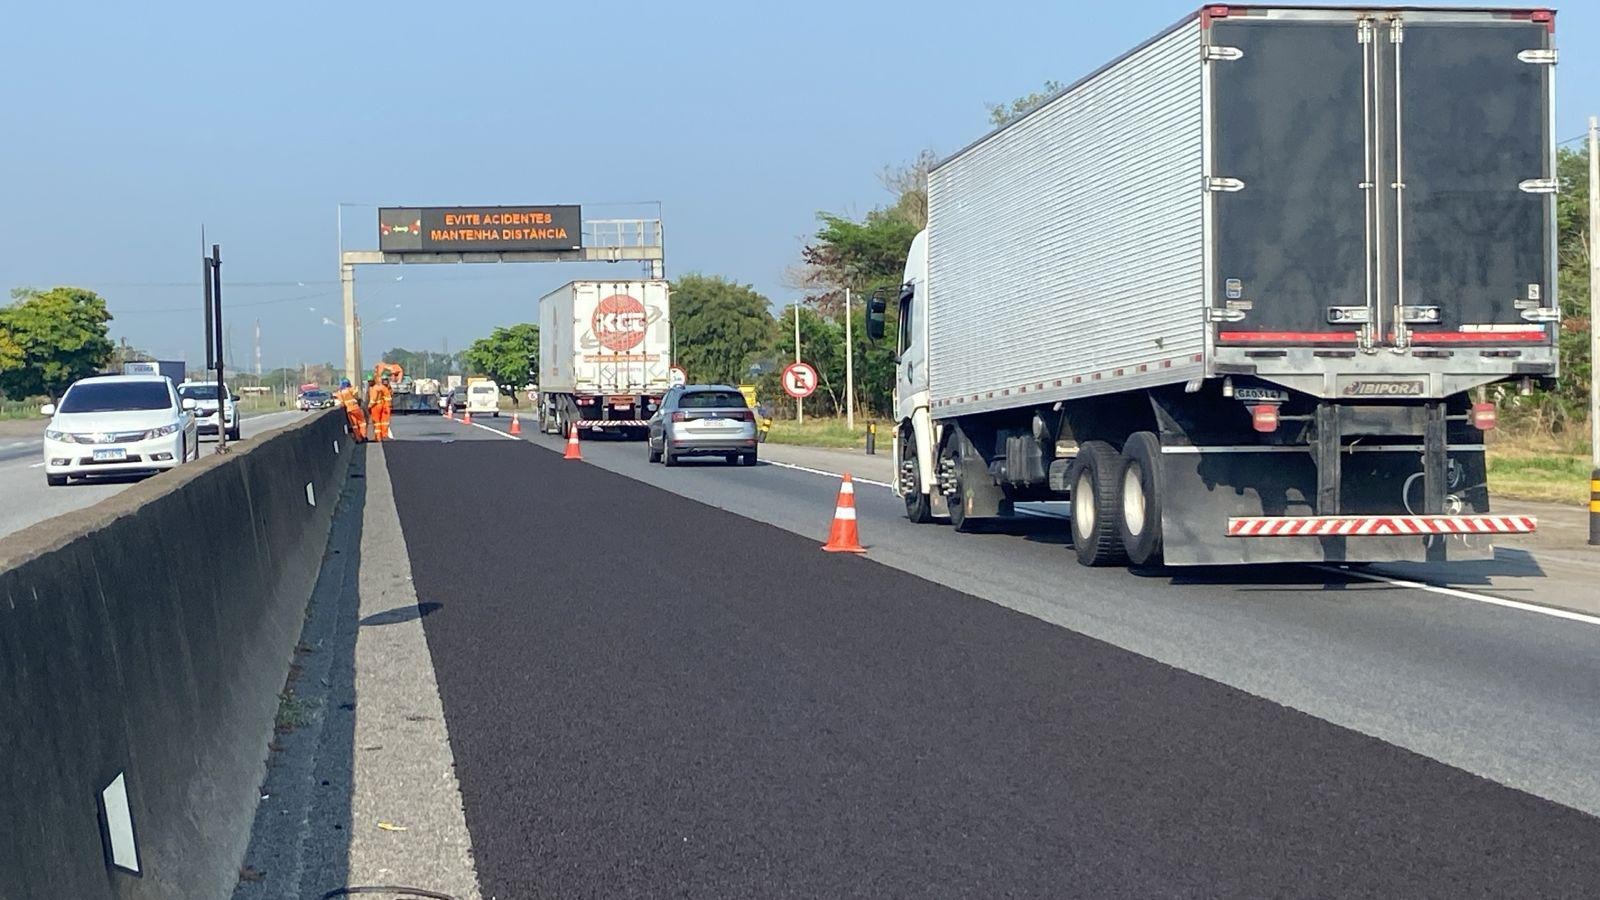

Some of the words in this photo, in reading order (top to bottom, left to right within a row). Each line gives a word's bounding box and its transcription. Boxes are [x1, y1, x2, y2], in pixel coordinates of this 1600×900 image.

[445, 214, 480, 226] EVITE
[483, 212, 553, 225] ACIDENTES
[430, 229, 500, 241] MANTENHA
